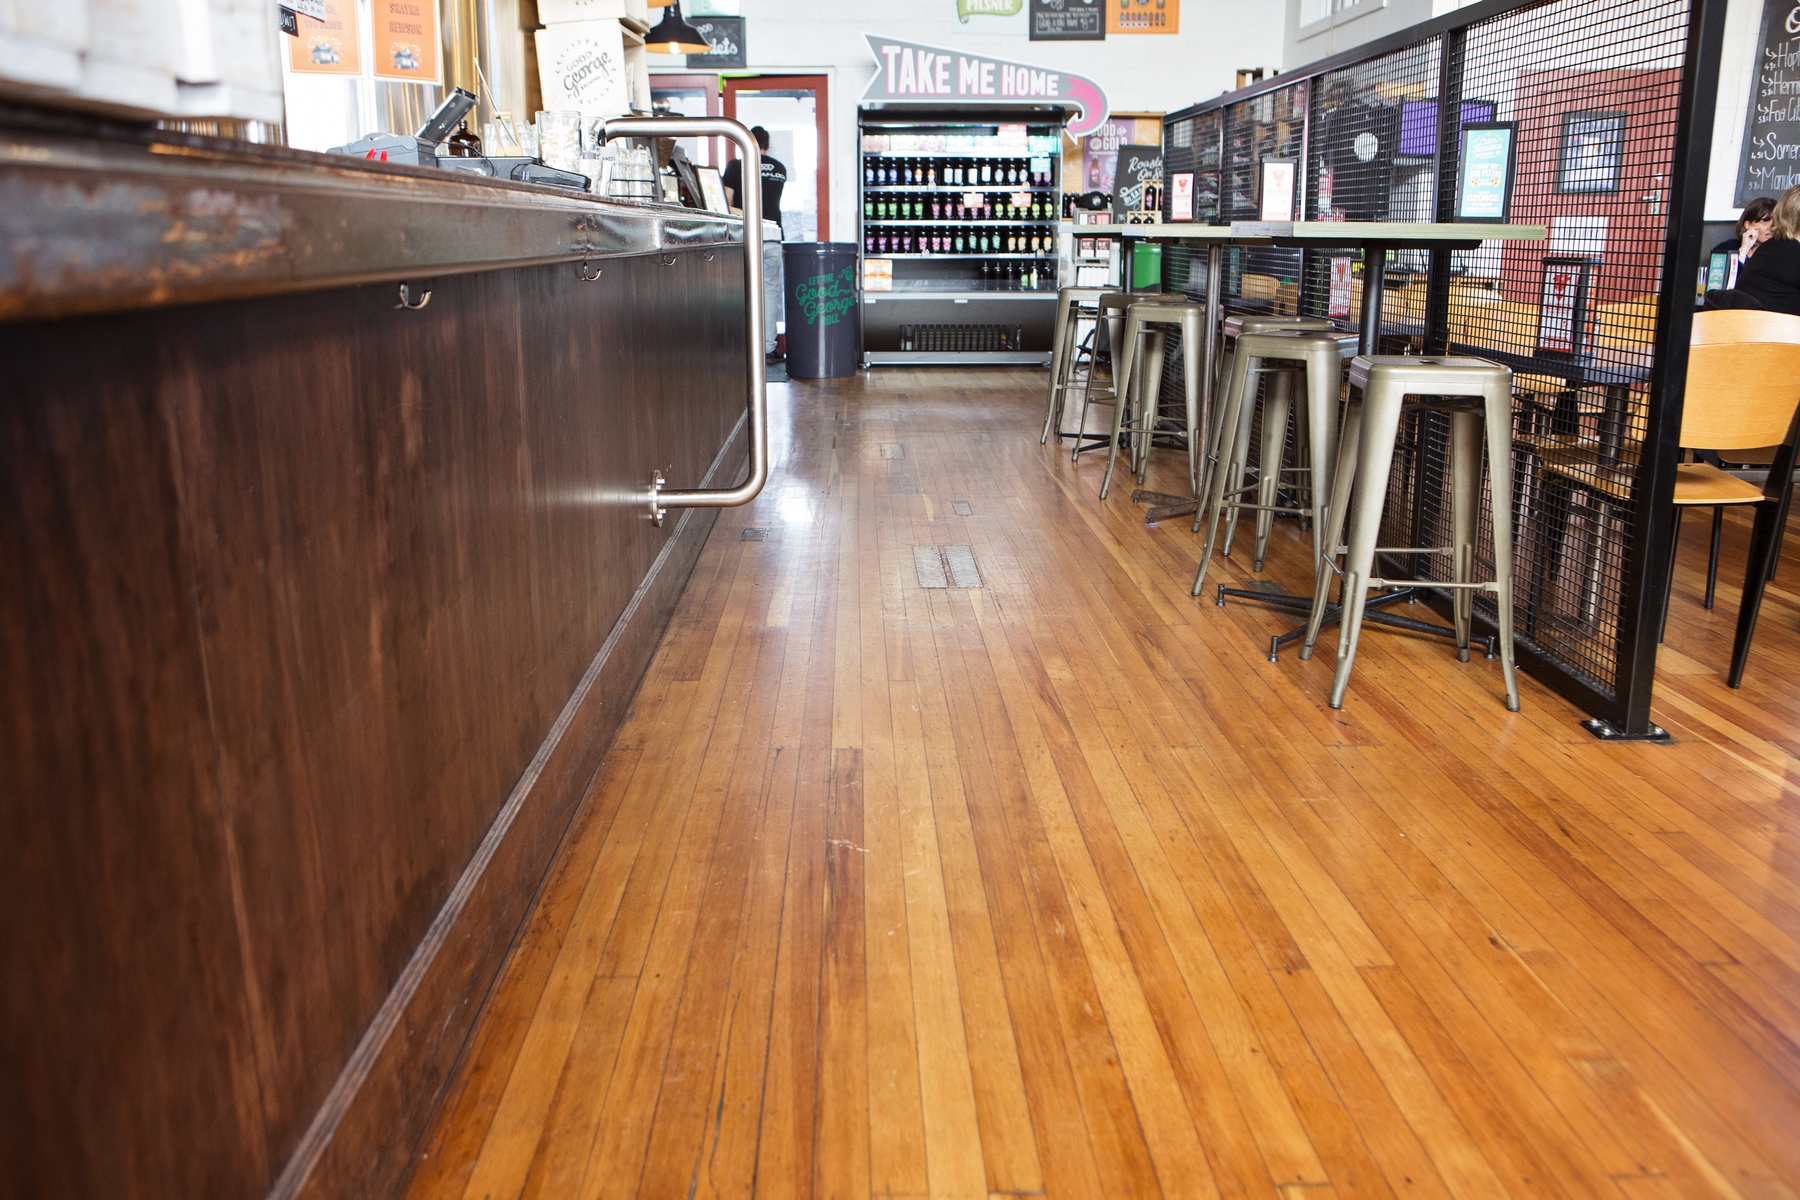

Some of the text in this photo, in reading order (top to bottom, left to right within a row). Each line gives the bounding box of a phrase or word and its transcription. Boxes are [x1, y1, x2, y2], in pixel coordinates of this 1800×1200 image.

[563, 51, 613, 98] George
[566, 50, 593, 72] GOOD
[881, 45, 1060, 98] TAKE ME HOME
[1136, 167, 1153, 182] On
[1466, 194, 1501, 202] GEORGE
[795, 279, 851, 306] Good
[803, 295, 855, 325] George
